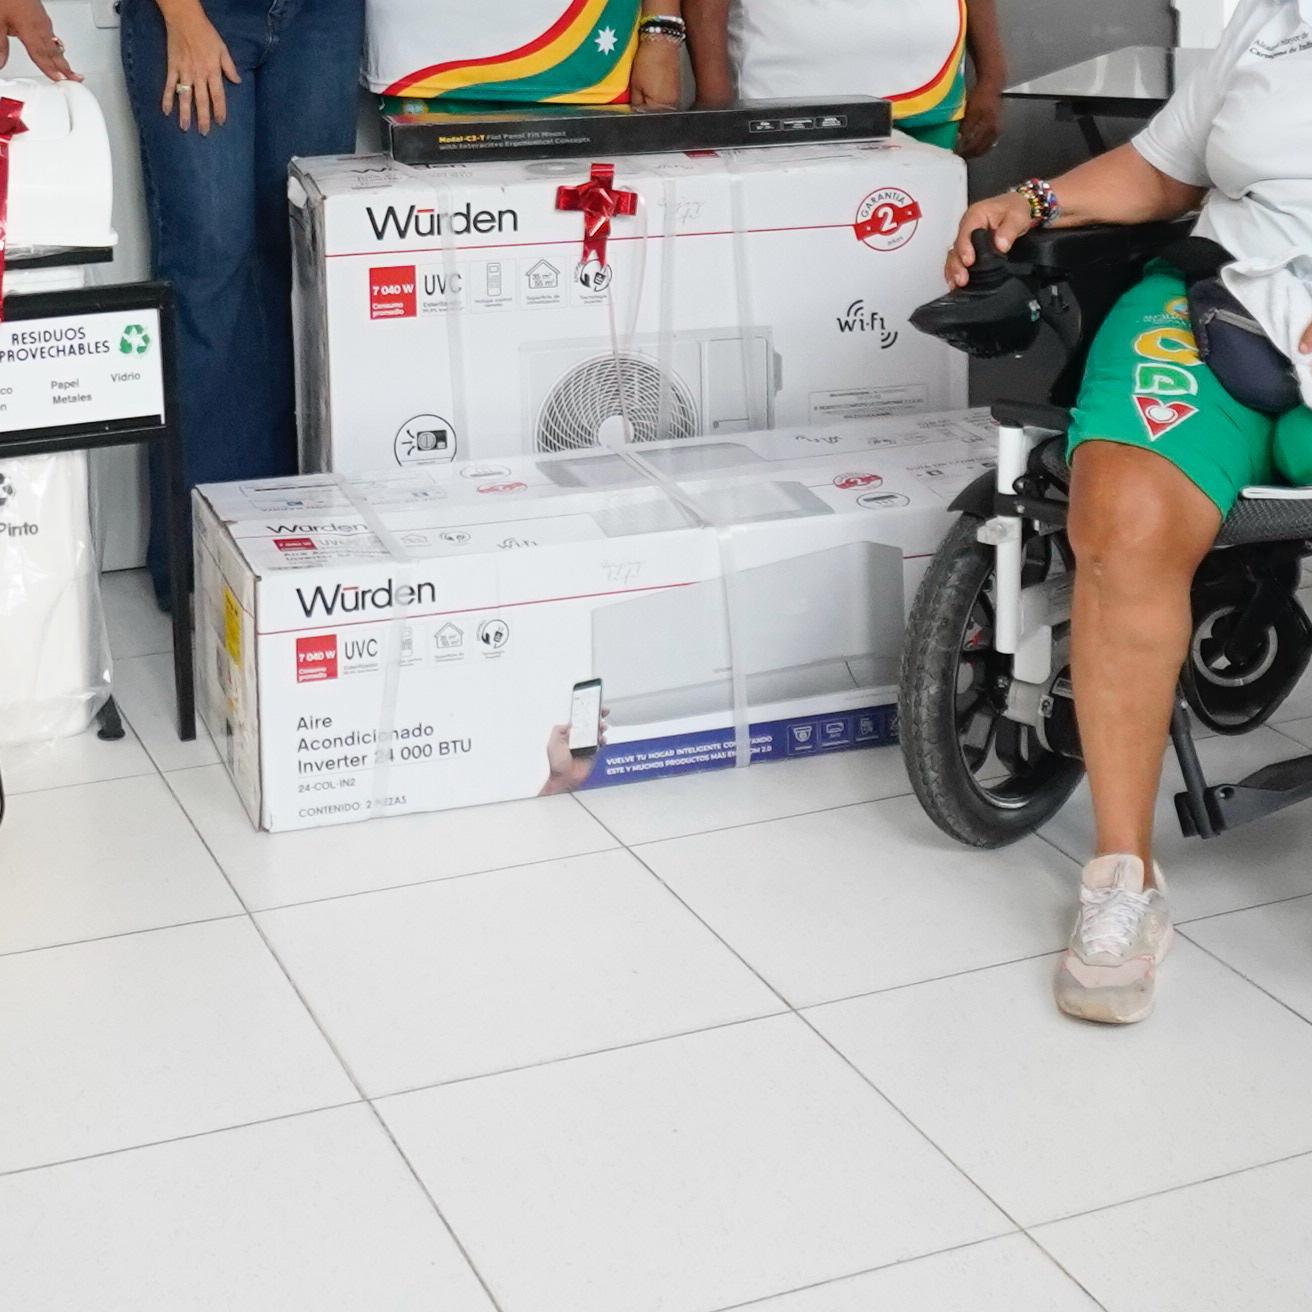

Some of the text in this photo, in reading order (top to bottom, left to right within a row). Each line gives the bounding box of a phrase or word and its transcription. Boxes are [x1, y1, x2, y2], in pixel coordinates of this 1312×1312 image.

[877, 206, 897, 233] 2
[424, 272, 463, 296] UVC
[11, 326, 86, 347] RESIDUOS
[51, 378, 80, 391] Papel
[110, 371, 141, 383] Vidrio
[52, 392, 93, 405] Metales
[344, 638, 378, 661] UVC
[296, 715, 333, 731] Aire
[297, 753, 368, 775] Inverter
[400, 743, 433, 761] 000
[439, 737, 473, 756] BTU
[606, 754, 636, 767] VUELVE
[637, 752, 648, 762] TU
[676, 742, 722, 756] INTELIGENTE
[606, 766, 625, 776] ESTE
[626, 766, 632, 774] Y
[631, 760, 665, 772] MUCHOS
[665, 754, 711, 768] PRODUCTOS
[375, 795, 408, 808] EZAS
